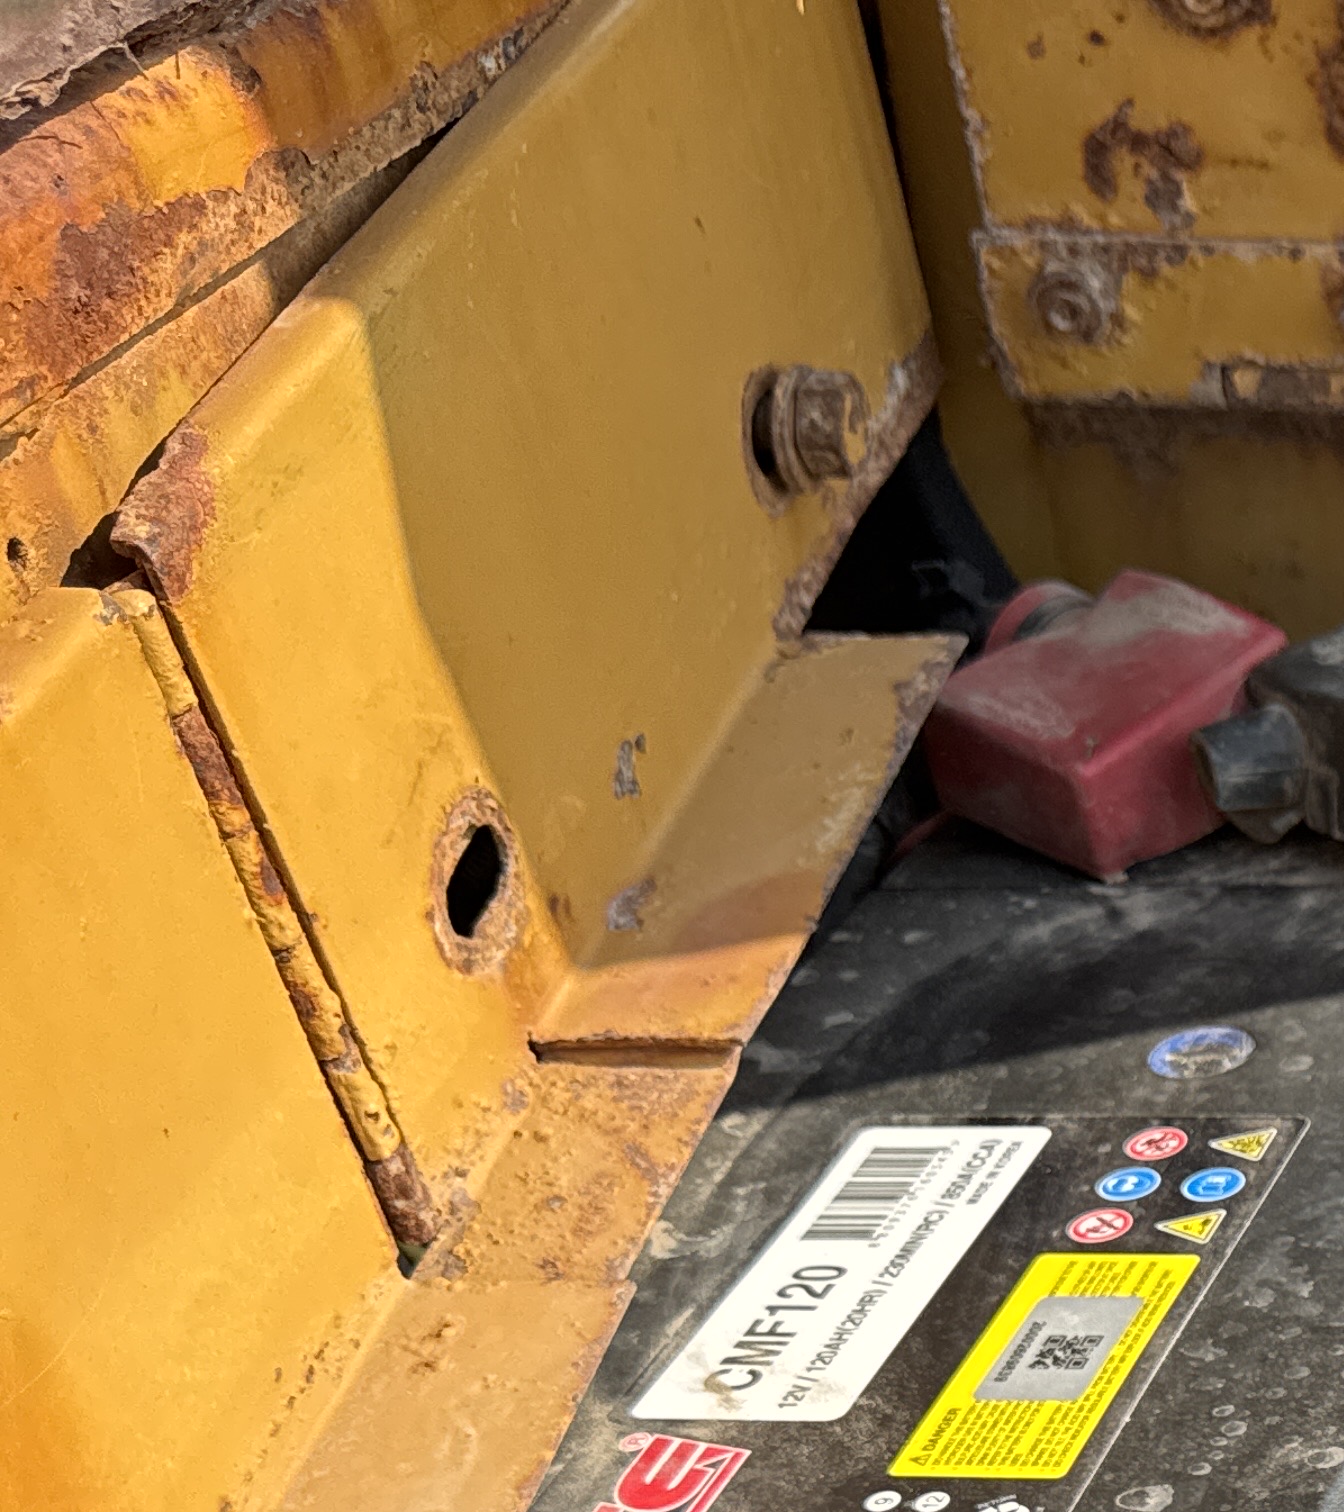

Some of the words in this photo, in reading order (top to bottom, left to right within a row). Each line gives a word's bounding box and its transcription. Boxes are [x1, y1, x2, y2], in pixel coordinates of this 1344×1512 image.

[703, 1264, 848, 1392] CMF120
[777, 1383, 813, 1409] 12V
[805, 1288, 888, 1373] 120AH(20HR)
[921, 1407, 962, 1452] DANGER
